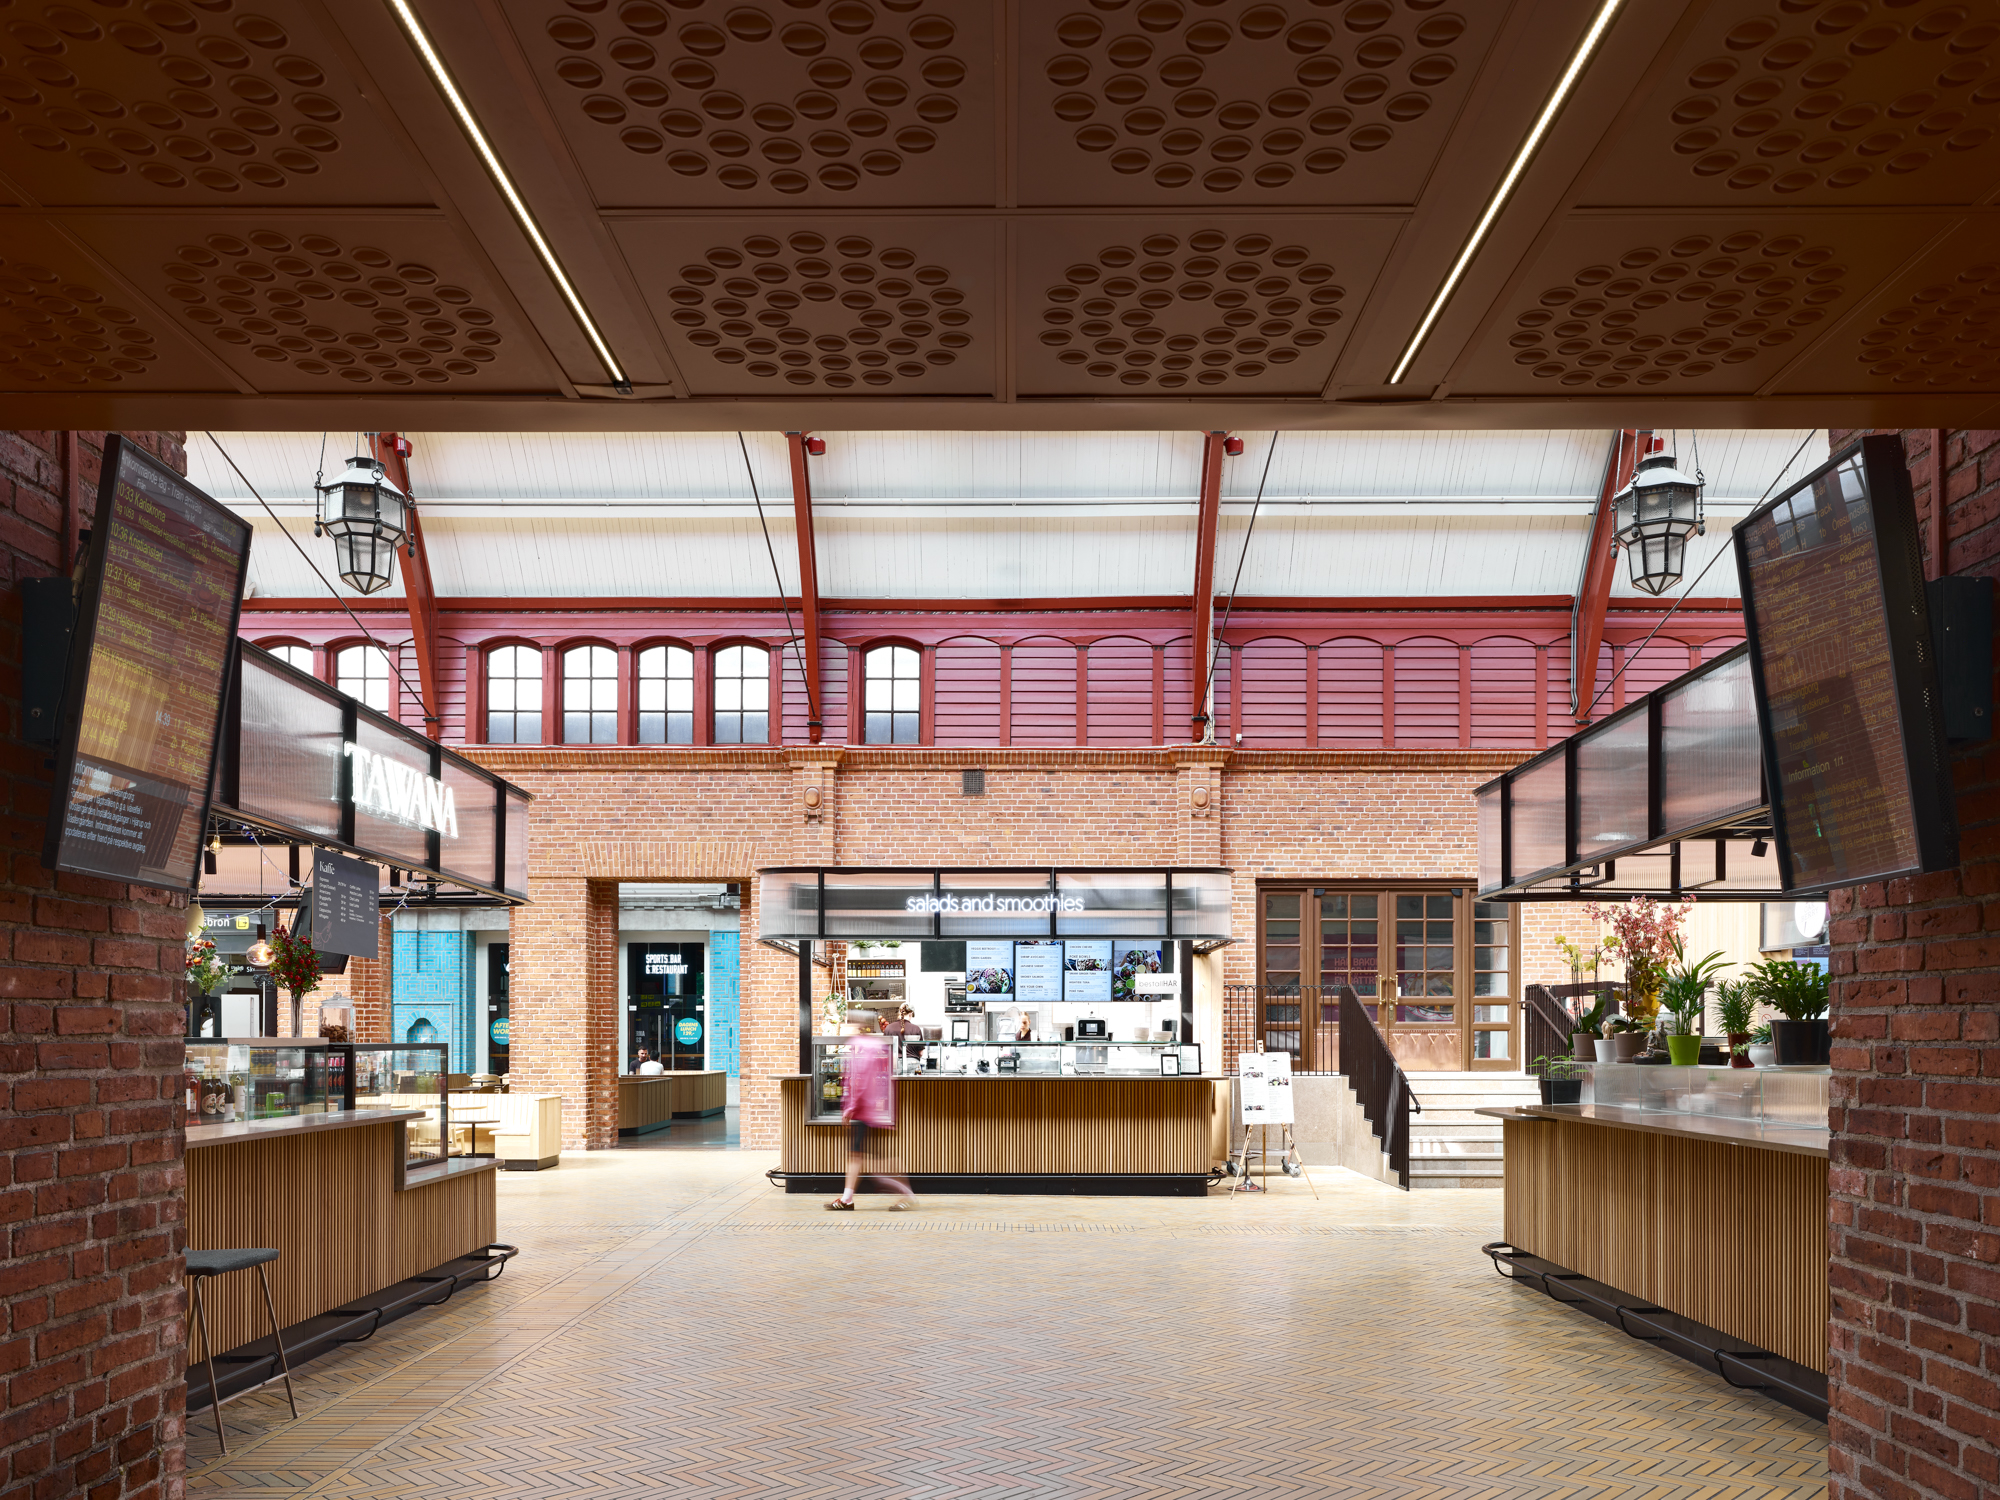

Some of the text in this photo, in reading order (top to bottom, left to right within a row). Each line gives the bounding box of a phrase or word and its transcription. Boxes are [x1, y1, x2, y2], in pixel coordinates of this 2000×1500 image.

[116, 481, 166, 522] 10:33 Karlskrona
[170, 483, 184, 502] Train
[184, 496, 202, 514] arrivals
[1813, 501, 1832, 521] Track
[1818, 525, 1826, 539] 1b
[1851, 520, 1867, 538] 1053
[110, 521, 163, 562] 10:36 Kristianstad
[1746, 520, 1805, 563] Train departures
[104, 561, 141, 592] 10:37 Ystad
[1857, 557, 1872, 574] 1213
[1768, 582, 1799, 605] Trelleborg
[98, 602, 152, 641] 10:39 Helsingborg
[1773, 613, 1809, 638] Helsingborg
[92, 642, 110, 661] 10:40
[110, 650, 146, 676] Köpenhamn
[86, 683, 131, 712] 10:41 Kävlinge
[1782, 682, 1818, 703] Helsingborg
[83, 703, 128, 732] 10:44 Kävlinge
[154, 709, 170, 726] 14:39
[1784, 695, 1829, 719] Lund Landskrona
[1842, 702, 1851, 715] 2b
[80, 723, 119, 748] 10:44 Malmö
[1787, 720, 1807, 736] Malmö
[1787, 754, 1844, 782] Information 1/1
[345, 741, 458, 838] TAWANA
[319, 860, 334, 874] Kaffe
[906, 894, 1084, 912] salads and smoothies
[646, 954, 681, 963] SPORTS BAR
[646, 965, 688, 974] & RESTAURANT
